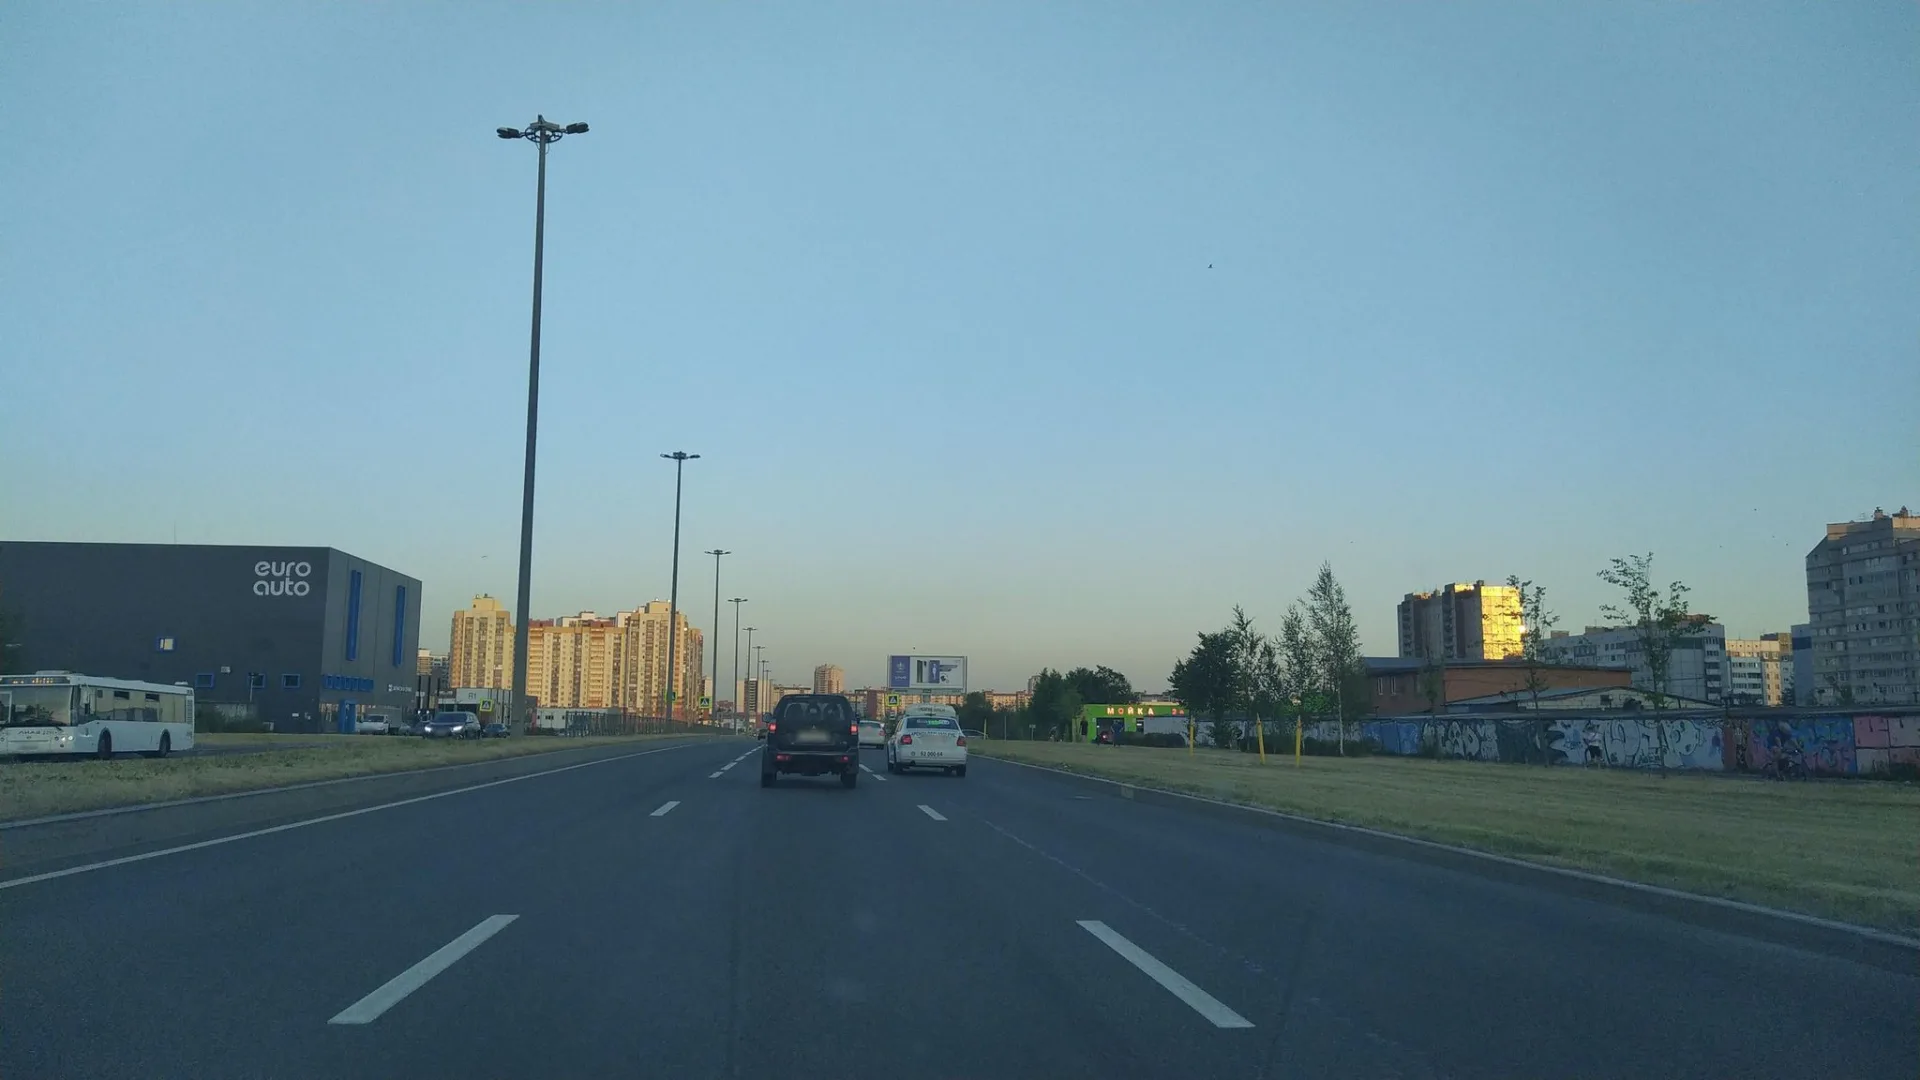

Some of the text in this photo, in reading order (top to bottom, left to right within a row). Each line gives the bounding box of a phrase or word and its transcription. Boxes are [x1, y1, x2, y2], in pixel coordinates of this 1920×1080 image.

[254, 560, 312, 577] euro
[252, 577, 311, 597] auto
[1106, 706, 1155, 716] МОЙКА
